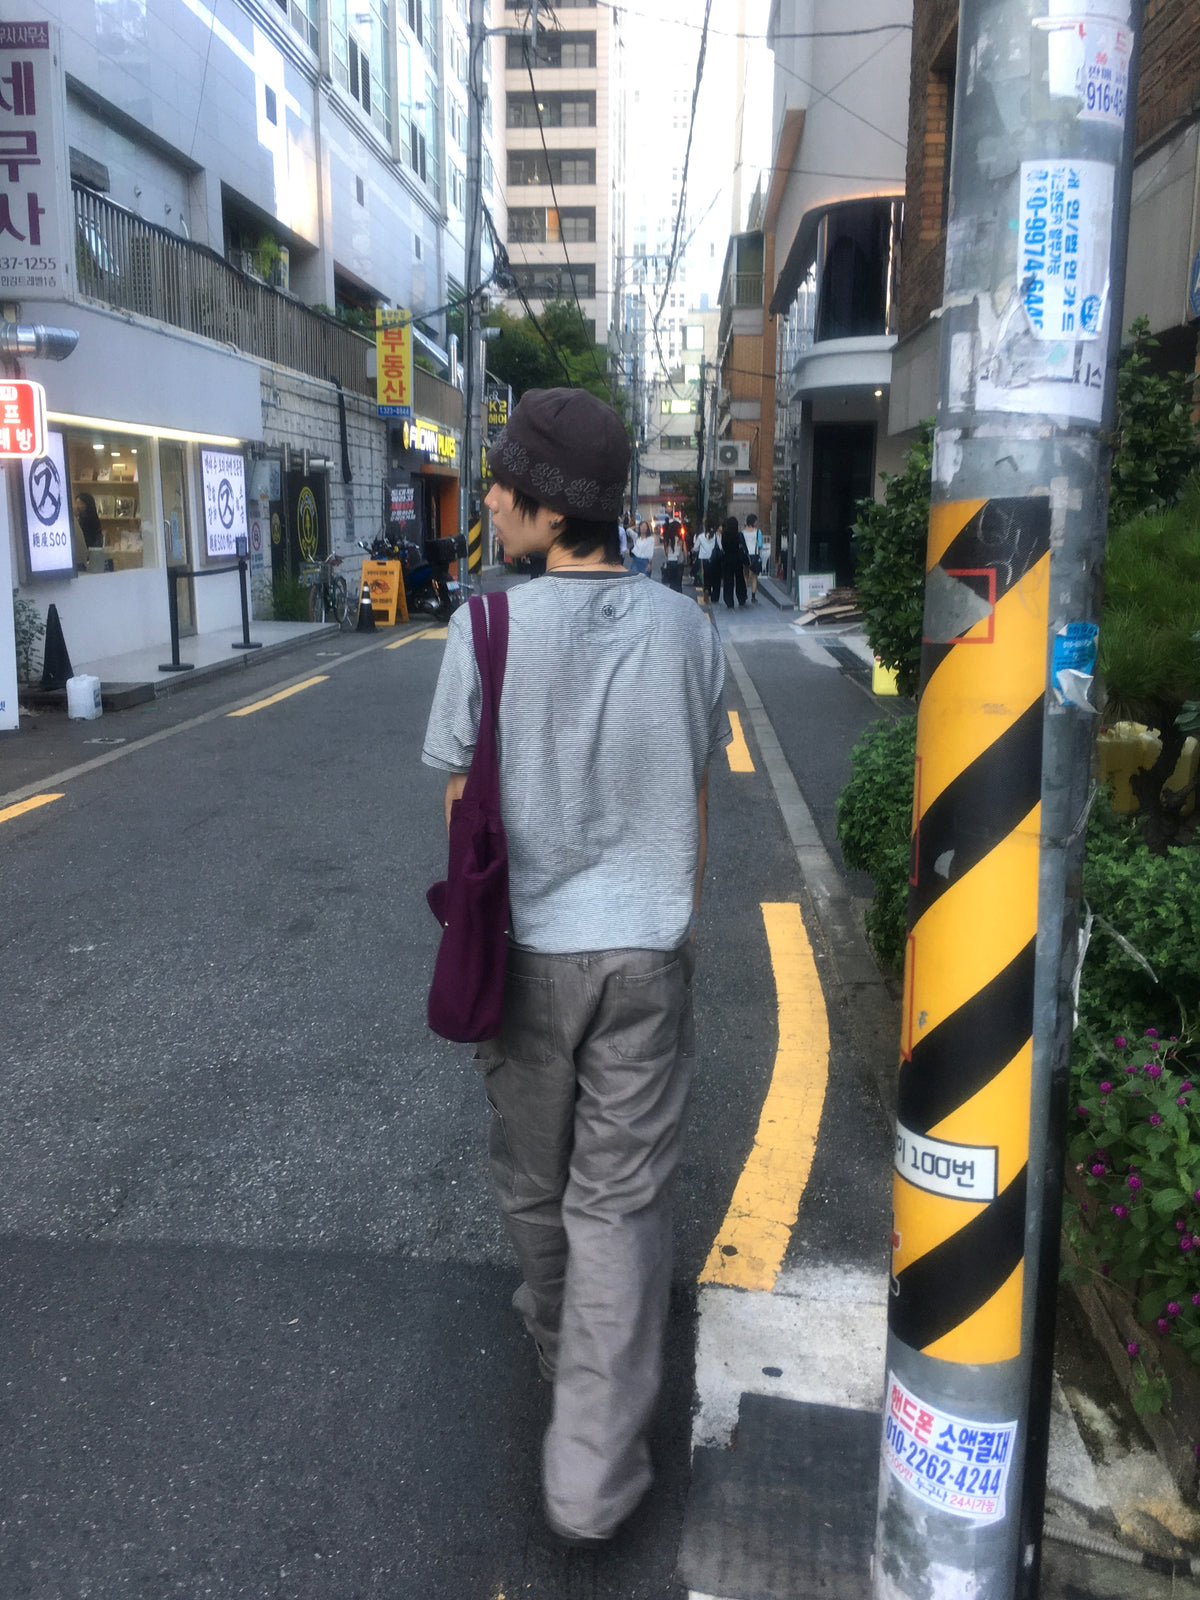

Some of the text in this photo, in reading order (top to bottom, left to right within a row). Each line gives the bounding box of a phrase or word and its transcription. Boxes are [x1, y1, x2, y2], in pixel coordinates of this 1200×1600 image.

[0, 256, 57, 270] 37-1255
[381, 328, 406, 404] 부동산
[488, 413, 507, 424] 헤어
[910, 1145, 975, 1188] 100번
[886, 1415, 1001, 1496] 010-2262-4244
[936, 1423, 1010, 1465] 소액결재
[916, 1477, 948, 1500] 누구나
